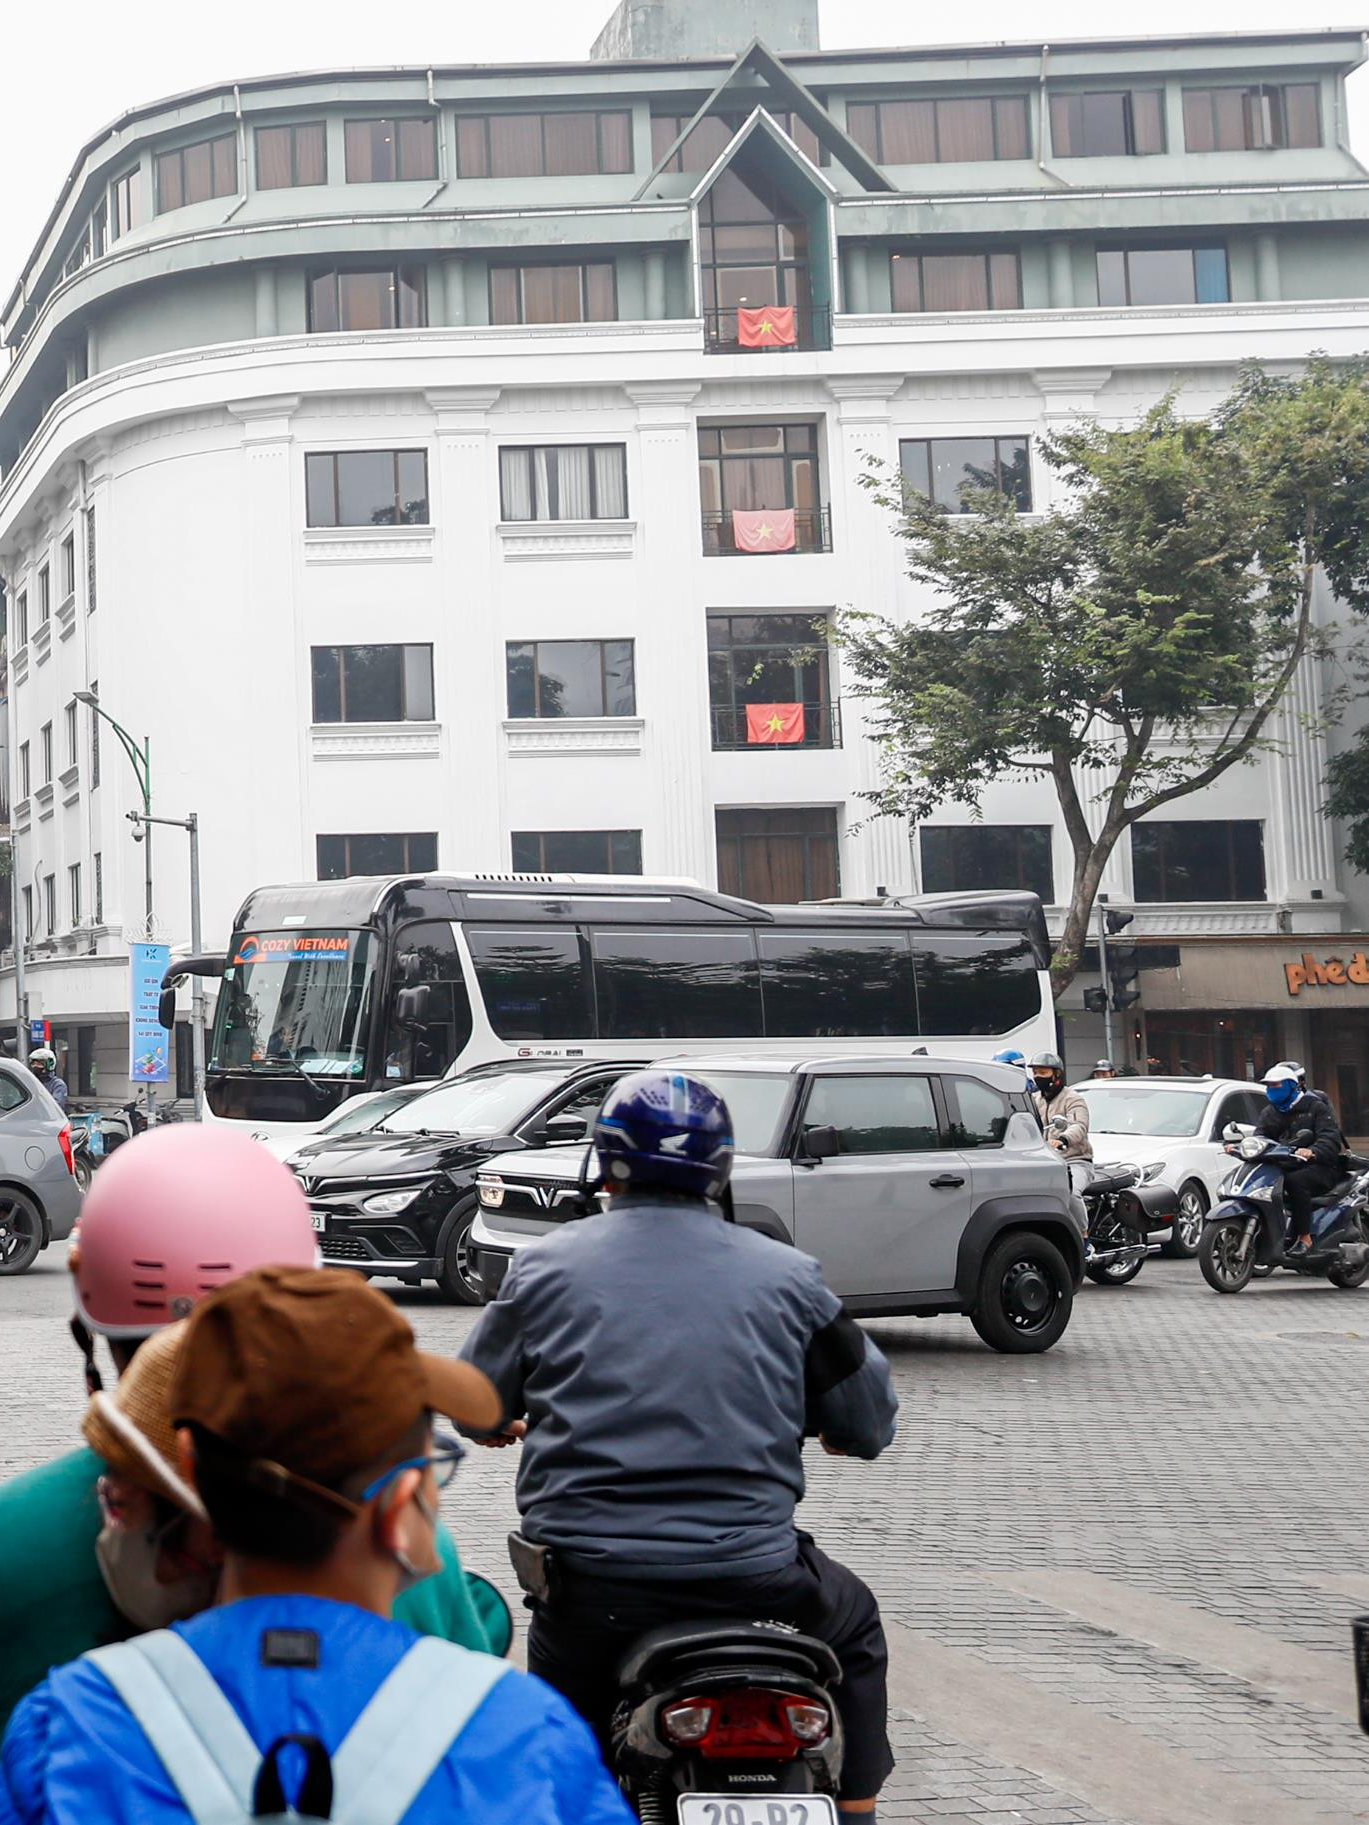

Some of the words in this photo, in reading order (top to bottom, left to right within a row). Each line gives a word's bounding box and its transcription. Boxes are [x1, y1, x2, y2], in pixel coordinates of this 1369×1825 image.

[261, 939, 291, 951] COZY
[293, 938, 348, 951] VIETNAM
[728, 1774, 777, 1782] HONDA
